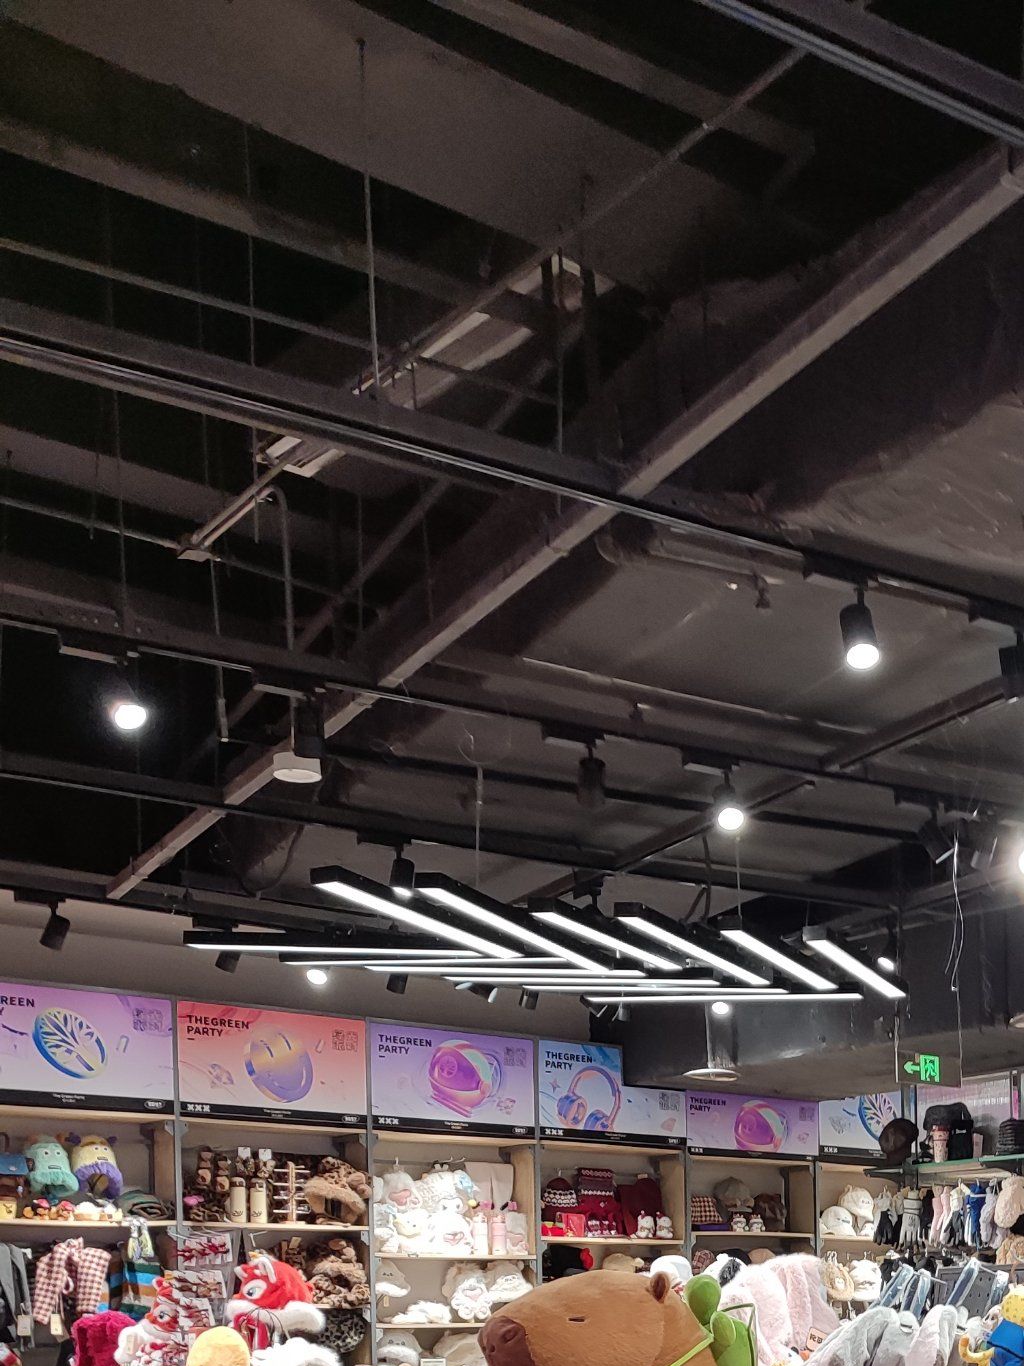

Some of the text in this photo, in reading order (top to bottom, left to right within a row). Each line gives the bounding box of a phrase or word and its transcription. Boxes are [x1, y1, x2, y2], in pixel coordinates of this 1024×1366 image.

[187, 1014, 249, 1030] THEGREEN
[186, 1025, 224, 1037] PARTY
[378, 1033, 432, 1048] THEGREEN
[378, 1044, 410, 1055] PARTY
[545, 1050, 593, 1064] THEGREEN
[545, 1060, 573, 1071] PARTY
[689, 1104, 711, 1113] PARTY
